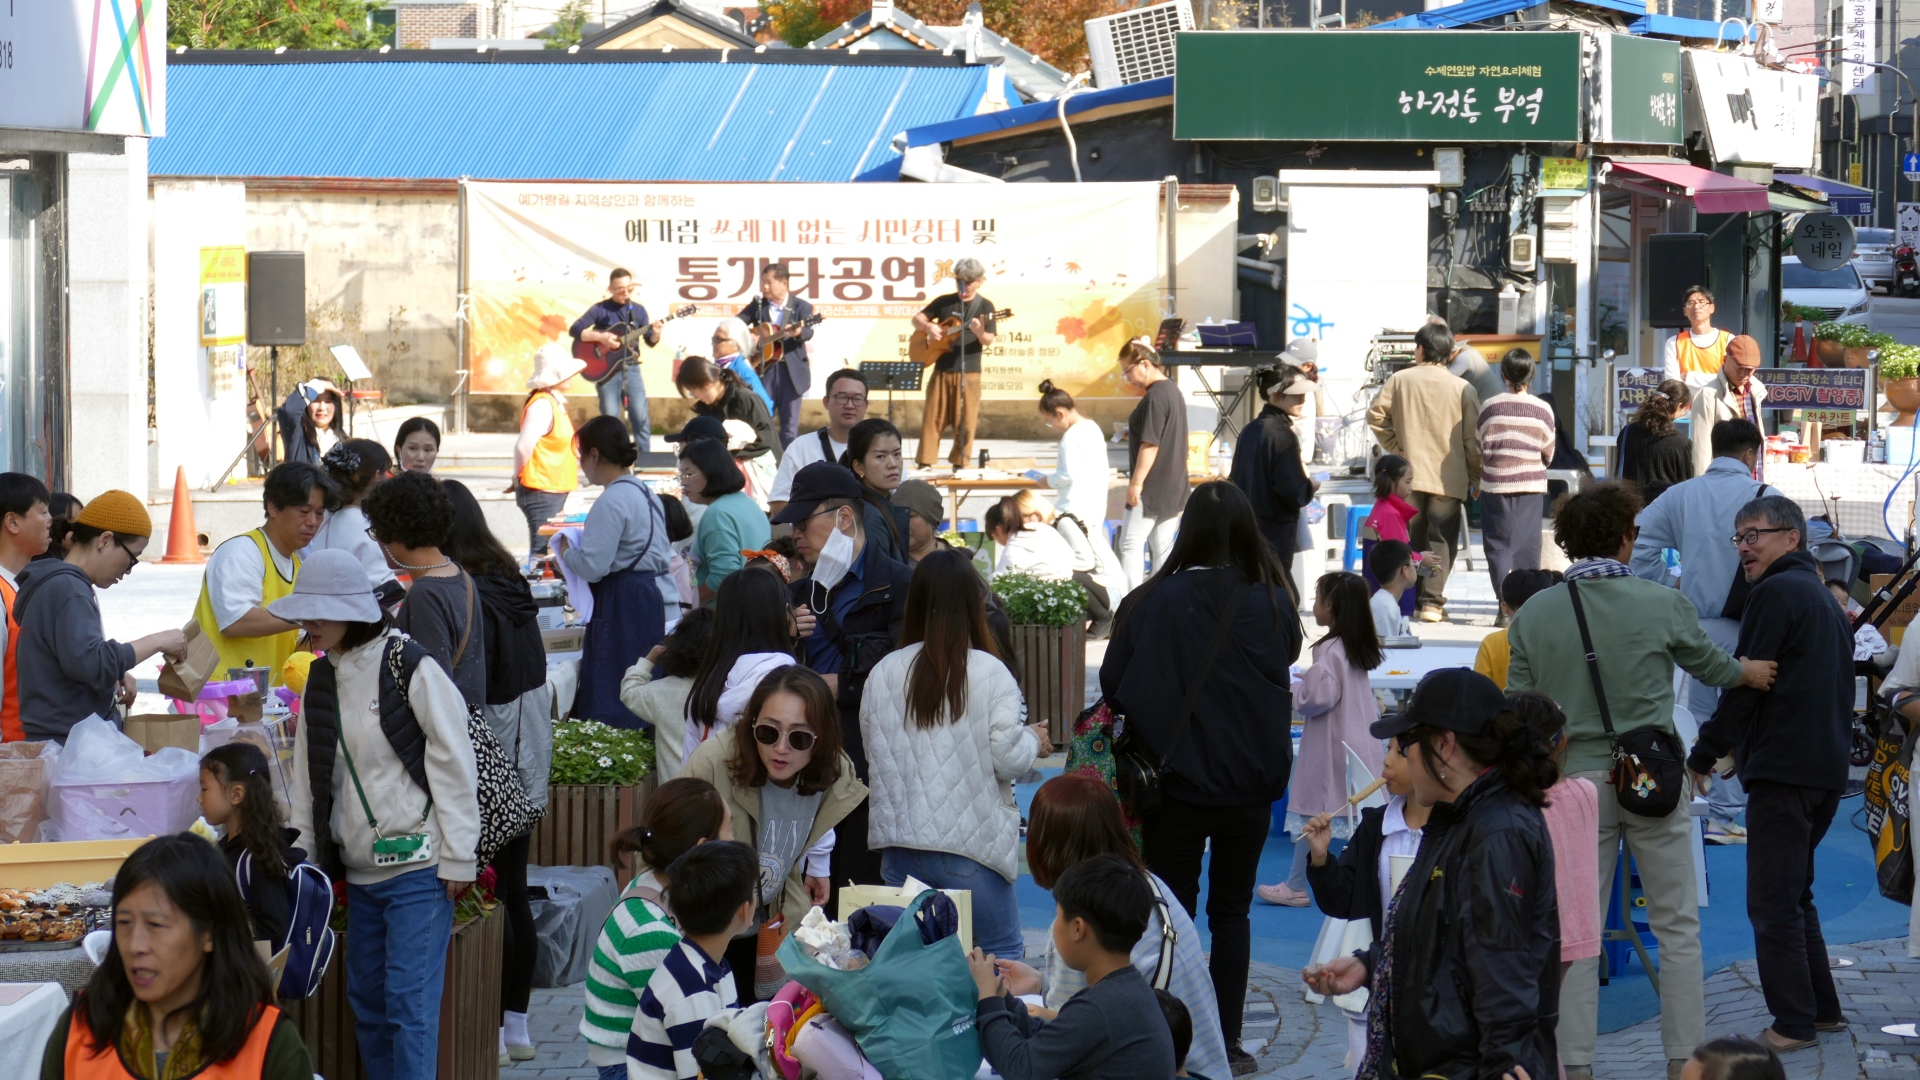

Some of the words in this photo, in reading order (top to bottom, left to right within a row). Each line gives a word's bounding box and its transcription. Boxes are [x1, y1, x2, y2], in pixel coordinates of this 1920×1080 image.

[1424, 64, 1477, 78] 수제연잎밥
[1479, 65, 1542, 78] 자연요리체험
[1398, 87, 1482, 124] 하정동
[518, 193, 570, 207] 예가람길
[575, 194, 639, 208] 지역상인과
[644, 194, 696, 208] 함께하는
[625, 218, 701, 245] 예가람
[709, 218, 787, 244] 쓰레기
[796, 218, 848, 245] 없는
[856, 218, 962, 245] 시민장터
[971, 218, 998, 246] 및
[1801, 221, 1842, 240] 오늘,
[1811, 241, 1844, 261] 네일
[675, 256, 928, 302] 통기타공연
[882, 304, 926, 317] 박장대소
[1009, 331, 1032, 344] 14시
[982, 346, 1035, 358] 수대(하늘중
[982, 365, 1023, 375] 체지원센터
[1766, 372, 1787, 384] 카트
[1789, 373, 1830, 386] 보관장소
[1833, 374, 1865, 387] 입니다
[1767, 385, 1814, 403] (CCTV
[1816, 386, 1865, 407] 촬영중)
[1807, 411, 1851, 424] 전용카트
